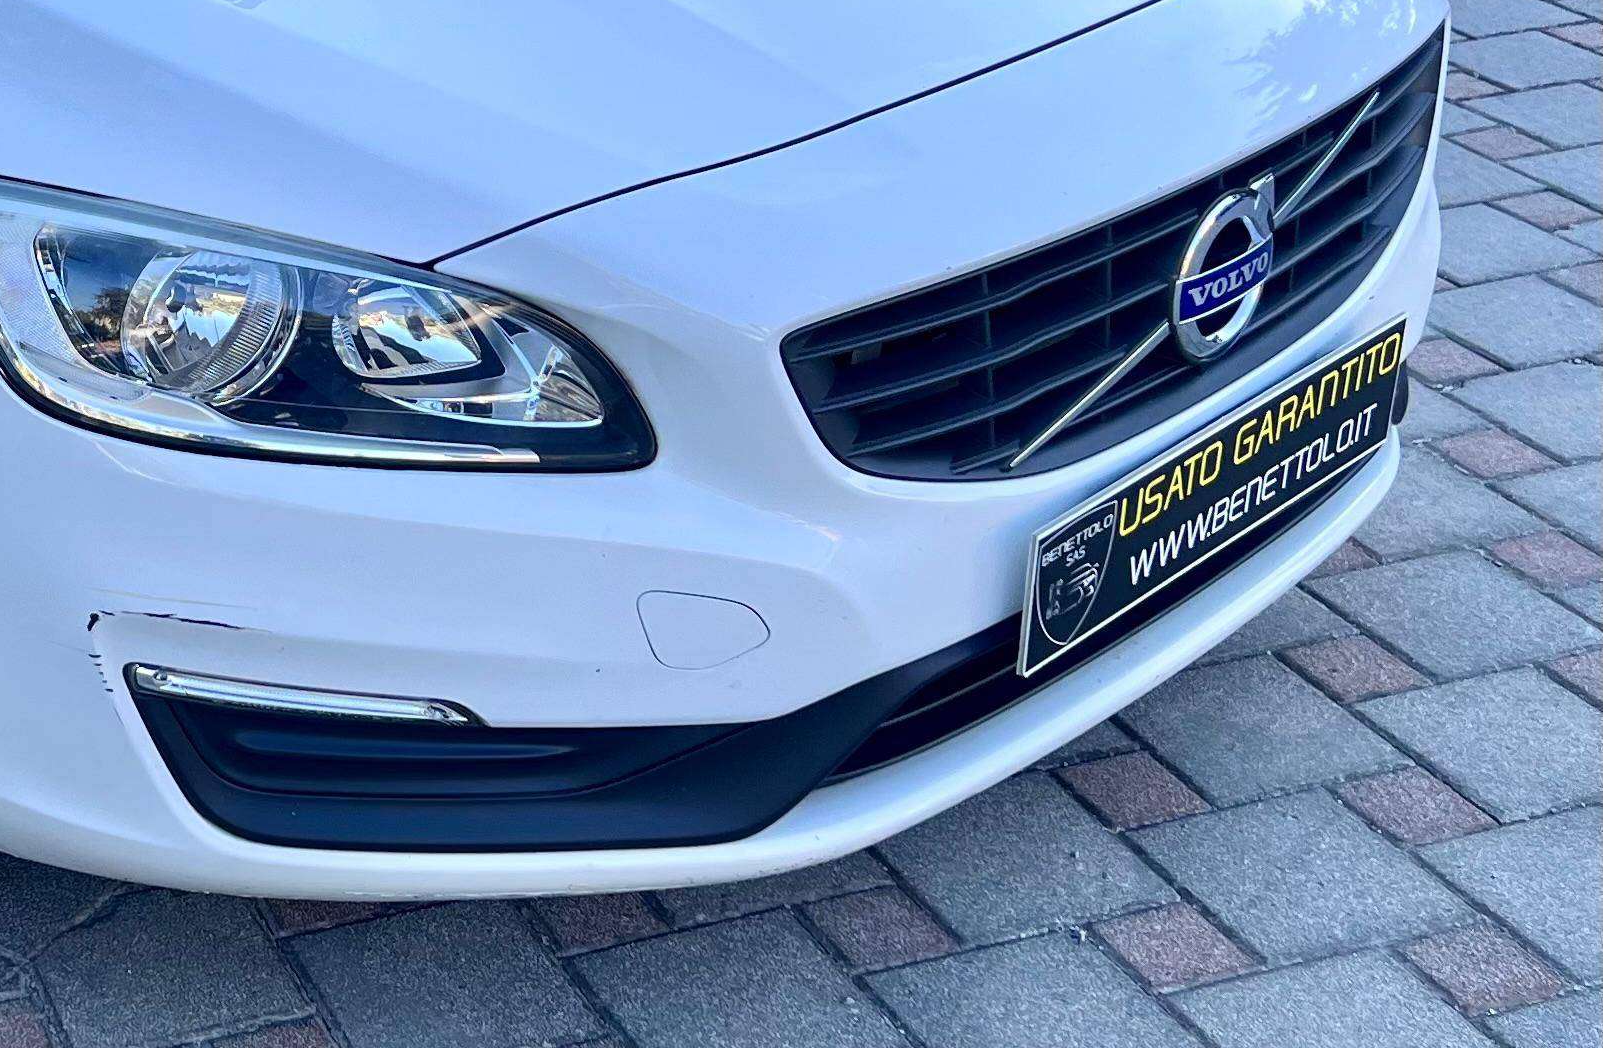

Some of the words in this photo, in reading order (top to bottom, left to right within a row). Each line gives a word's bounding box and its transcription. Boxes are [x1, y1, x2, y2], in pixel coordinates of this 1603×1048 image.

[1187, 251, 1269, 307] VOLVO
[1118, 440, 1223, 537] USATO
[1233, 332, 1402, 465] GARANTITO
[1129, 402, 1378, 586] WWW.BENETTOLO.IT
[1041, 513, 1114, 567] BENETTOLO
[1065, 544, 1086, 567] SAS
